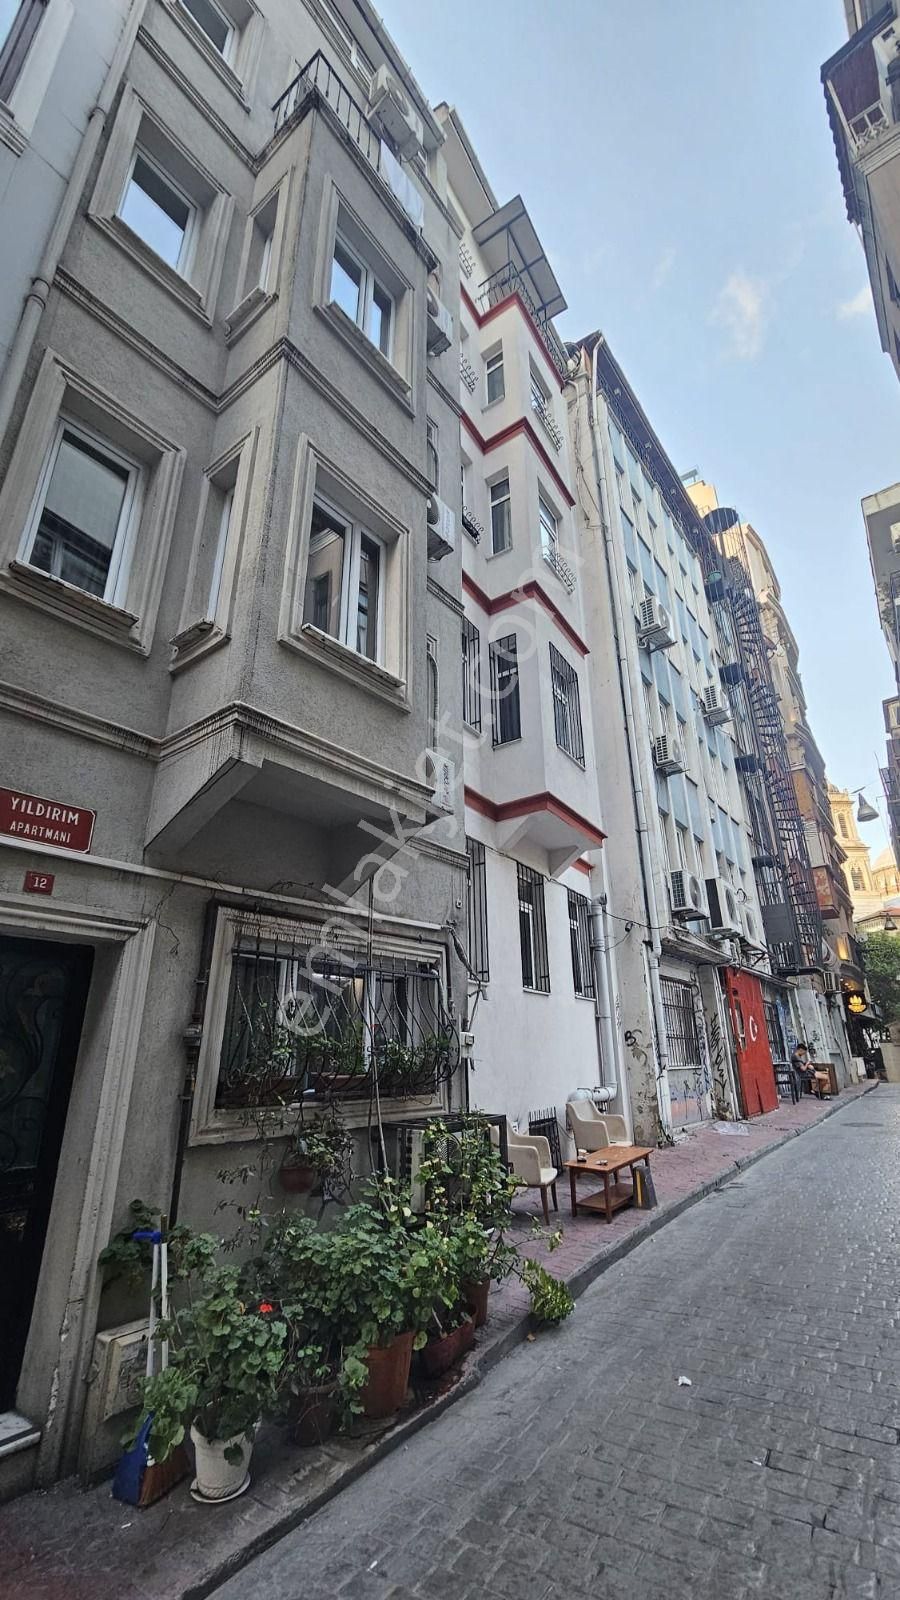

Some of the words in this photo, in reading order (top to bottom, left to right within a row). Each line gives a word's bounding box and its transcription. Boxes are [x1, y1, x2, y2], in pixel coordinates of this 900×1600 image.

[11, 797, 79, 825] YILDIRIM
[10, 821, 71, 843] APARTMANI
[33, 876, 47, 889] 12
